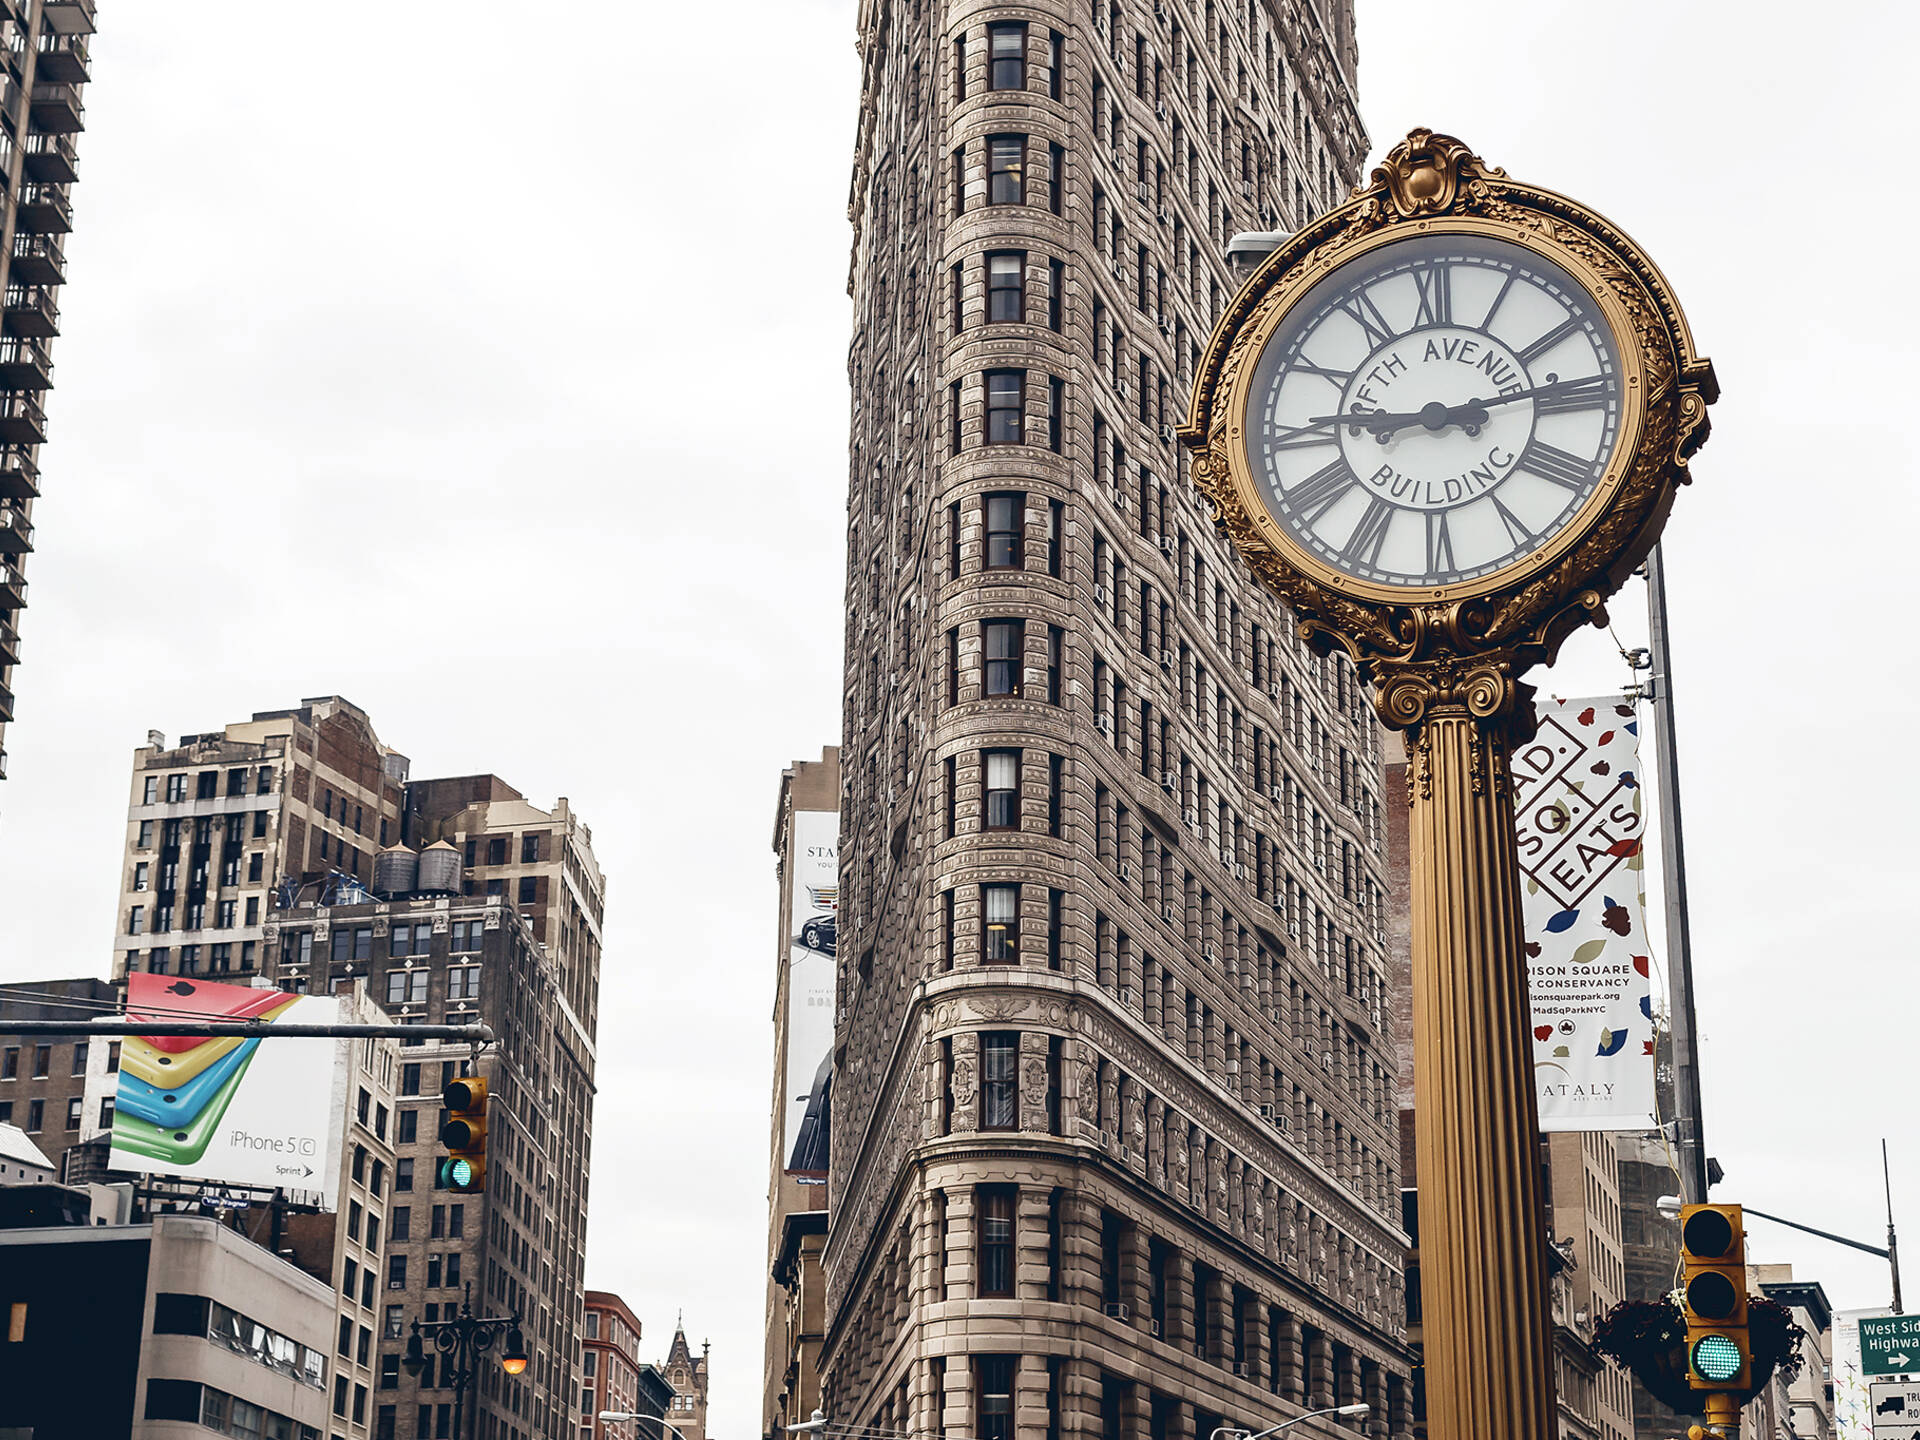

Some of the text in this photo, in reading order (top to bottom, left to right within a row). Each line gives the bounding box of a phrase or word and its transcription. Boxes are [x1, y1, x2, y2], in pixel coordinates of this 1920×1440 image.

[1353, 352, 1408, 412] IFTH
[1369, 446, 1514, 505] BUILDING
[1516, 806, 1580, 856] SQ.
[1550, 803, 1640, 892] EATS
[1572, 964, 1630, 976] SQUARE
[1537, 978, 1630, 989] CONSERVANCY
[1530, 992, 1620, 1002] isonsquarepark.org
[1533, 1005, 1606, 1016] MadSqParkNYC
[230, 1130, 283, 1152] iPhone
[275, 1164, 301, 1176] Sprint
[1863, 1322, 1897, 1336] West
[1869, 1337, 1920, 1353] Highwa
